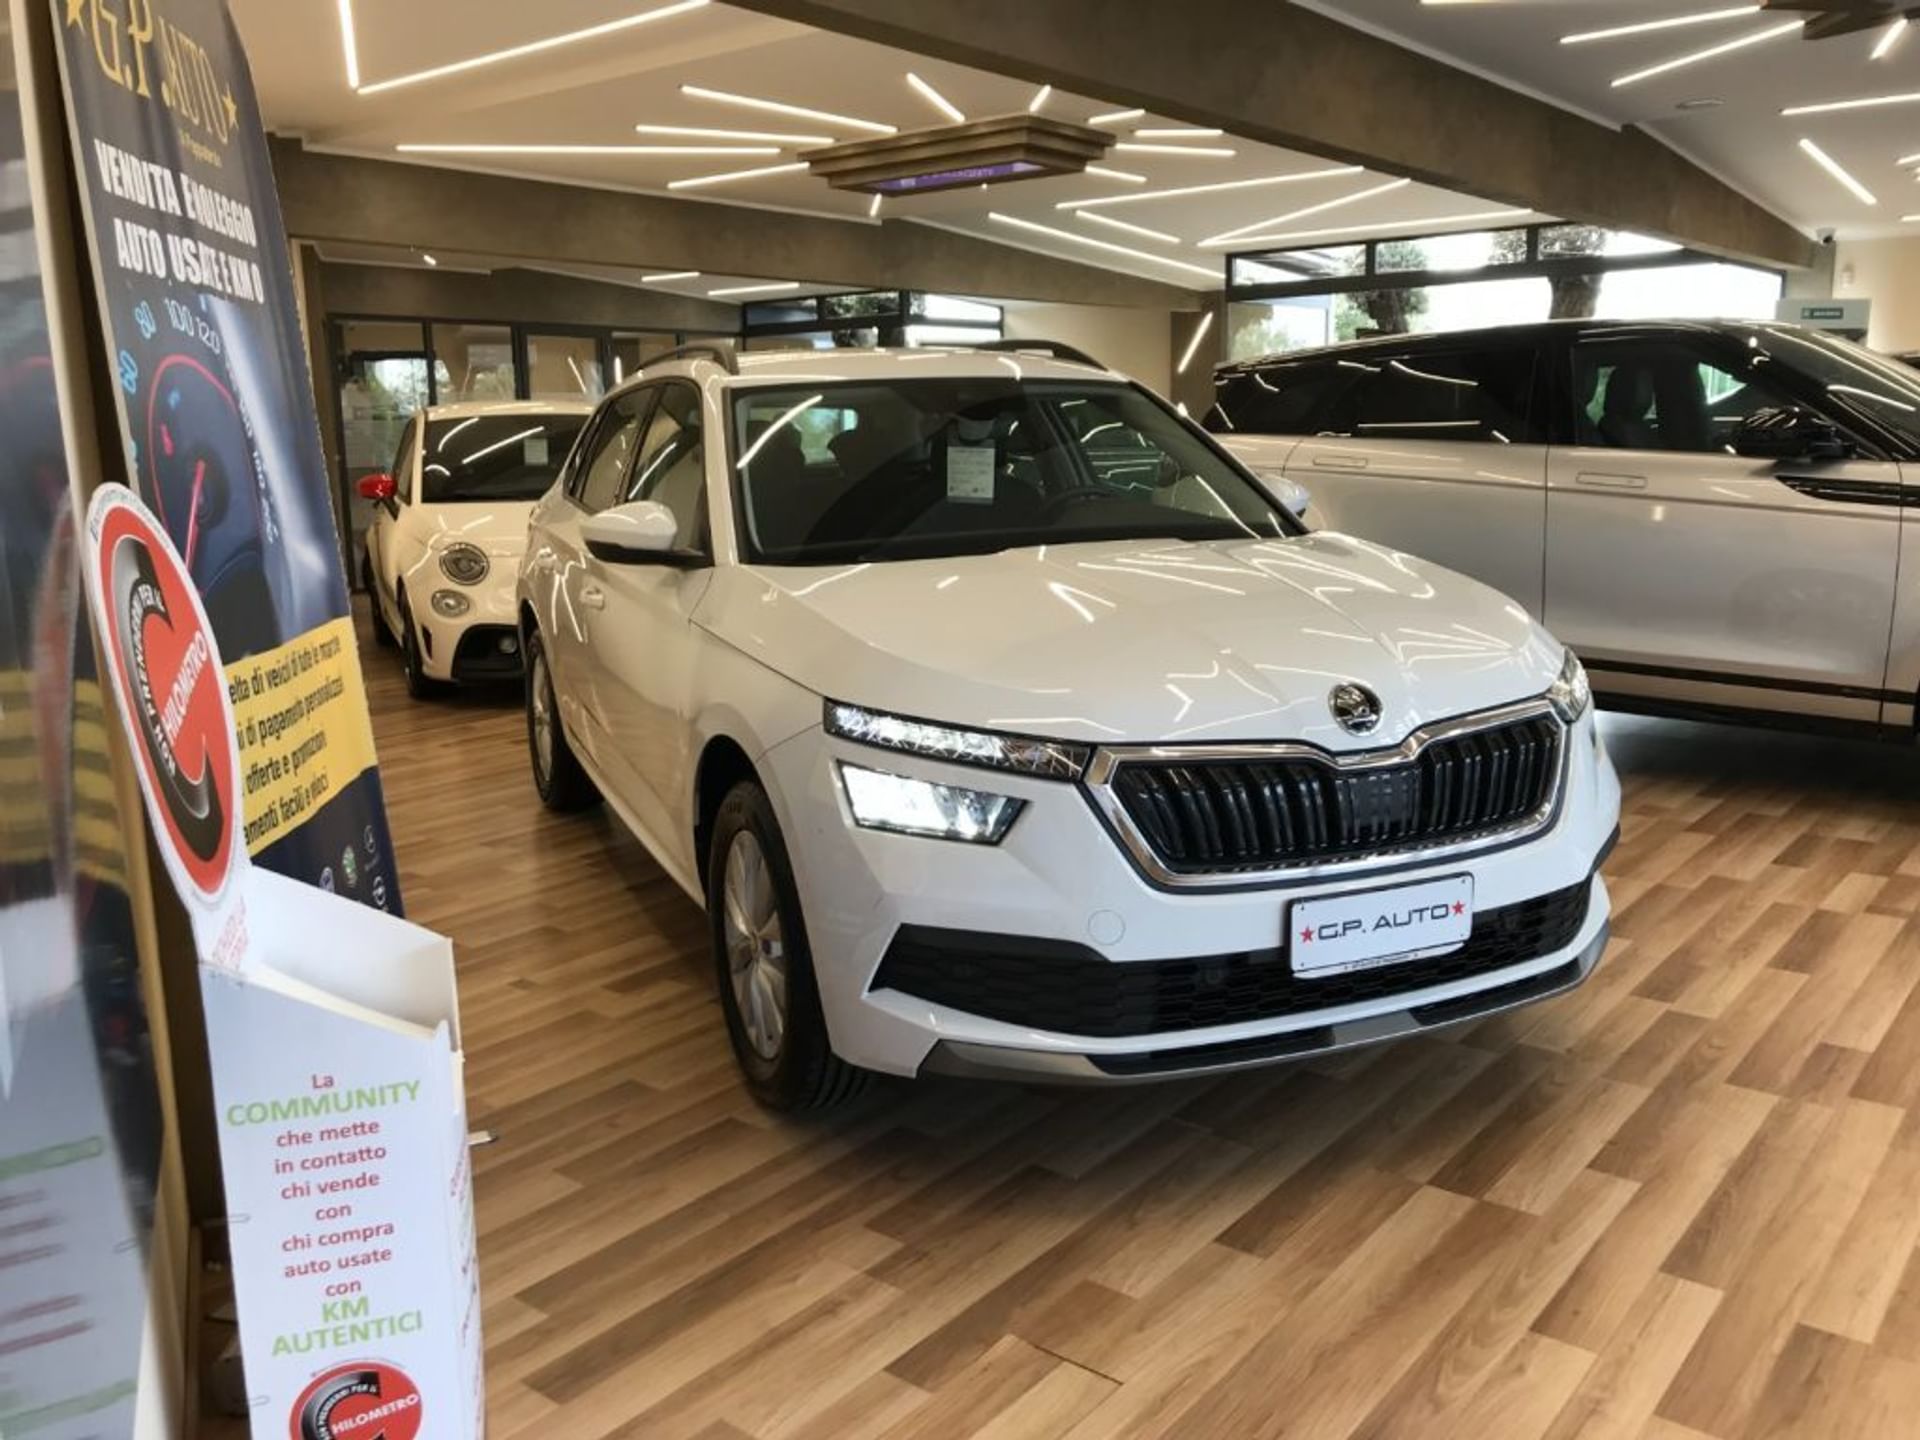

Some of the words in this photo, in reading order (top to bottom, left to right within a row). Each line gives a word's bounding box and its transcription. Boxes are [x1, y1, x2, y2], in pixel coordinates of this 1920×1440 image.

[158, 16, 228, 145] AUTO
[94, 138, 182, 217] VENDITA
[179, 171, 197, 220] E
[192, 180, 258, 247] NOLEGGIO
[113, 217, 167, 279] AUTO
[166, 233, 223, 292] USATE
[218, 251, 232, 294] E
[227, 254, 255, 301] KM
[164, 297, 195, 337] 100
[195, 316, 221, 355] 120
[229, 674, 251, 705] elta
[251, 666, 265, 696] di
[246, 756, 282, 795] offerte
[242, 800, 280, 846] amenti
[1317, 918, 1367, 941] G.P.
[1372, 903, 1449, 931] AUTO
[312, 1073, 334, 1090] La
[226, 1080, 420, 1127] COMMUNITY
[276, 1129, 313, 1148] che
[319, 1120, 380, 1142] mette
[274, 1158, 294, 1174] in
[299, 1146, 387, 1172] contatto
[281, 1181, 311, 1200] chi
[317, 1172, 380, 1195] vende
[315, 1204, 352, 1221] con
[282, 1233, 312, 1252] chi
[318, 1222, 395, 1249] compra
[284, 1259, 331, 1279] auto
[337, 1248, 393, 1271] usate
[325, 1279, 362, 1298] con
[321, 1296, 370, 1323] KM
[271, 1310, 423, 1357] AUTENTICI
